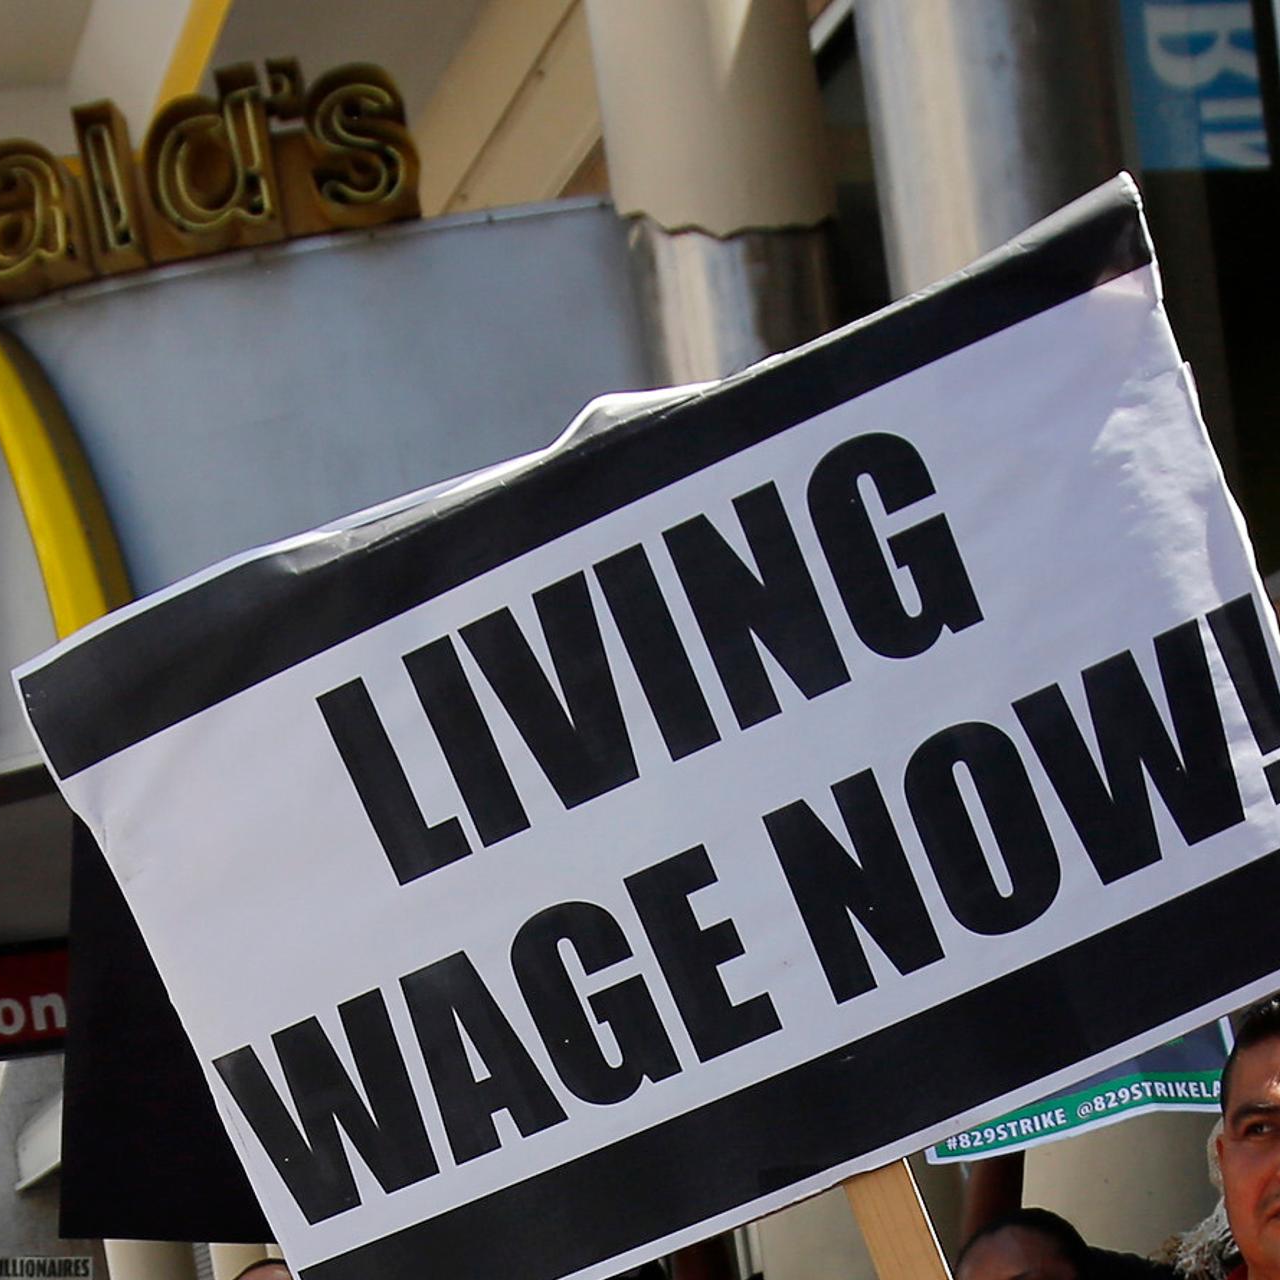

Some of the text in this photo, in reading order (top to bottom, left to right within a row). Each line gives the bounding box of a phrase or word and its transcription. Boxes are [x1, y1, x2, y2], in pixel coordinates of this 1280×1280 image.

[315, 431, 985, 887] LIVING
[213, 843, 783, 1225] WAGE
[946, 1080, 1222, 1152] #829STRIKE @829STRIKELA
